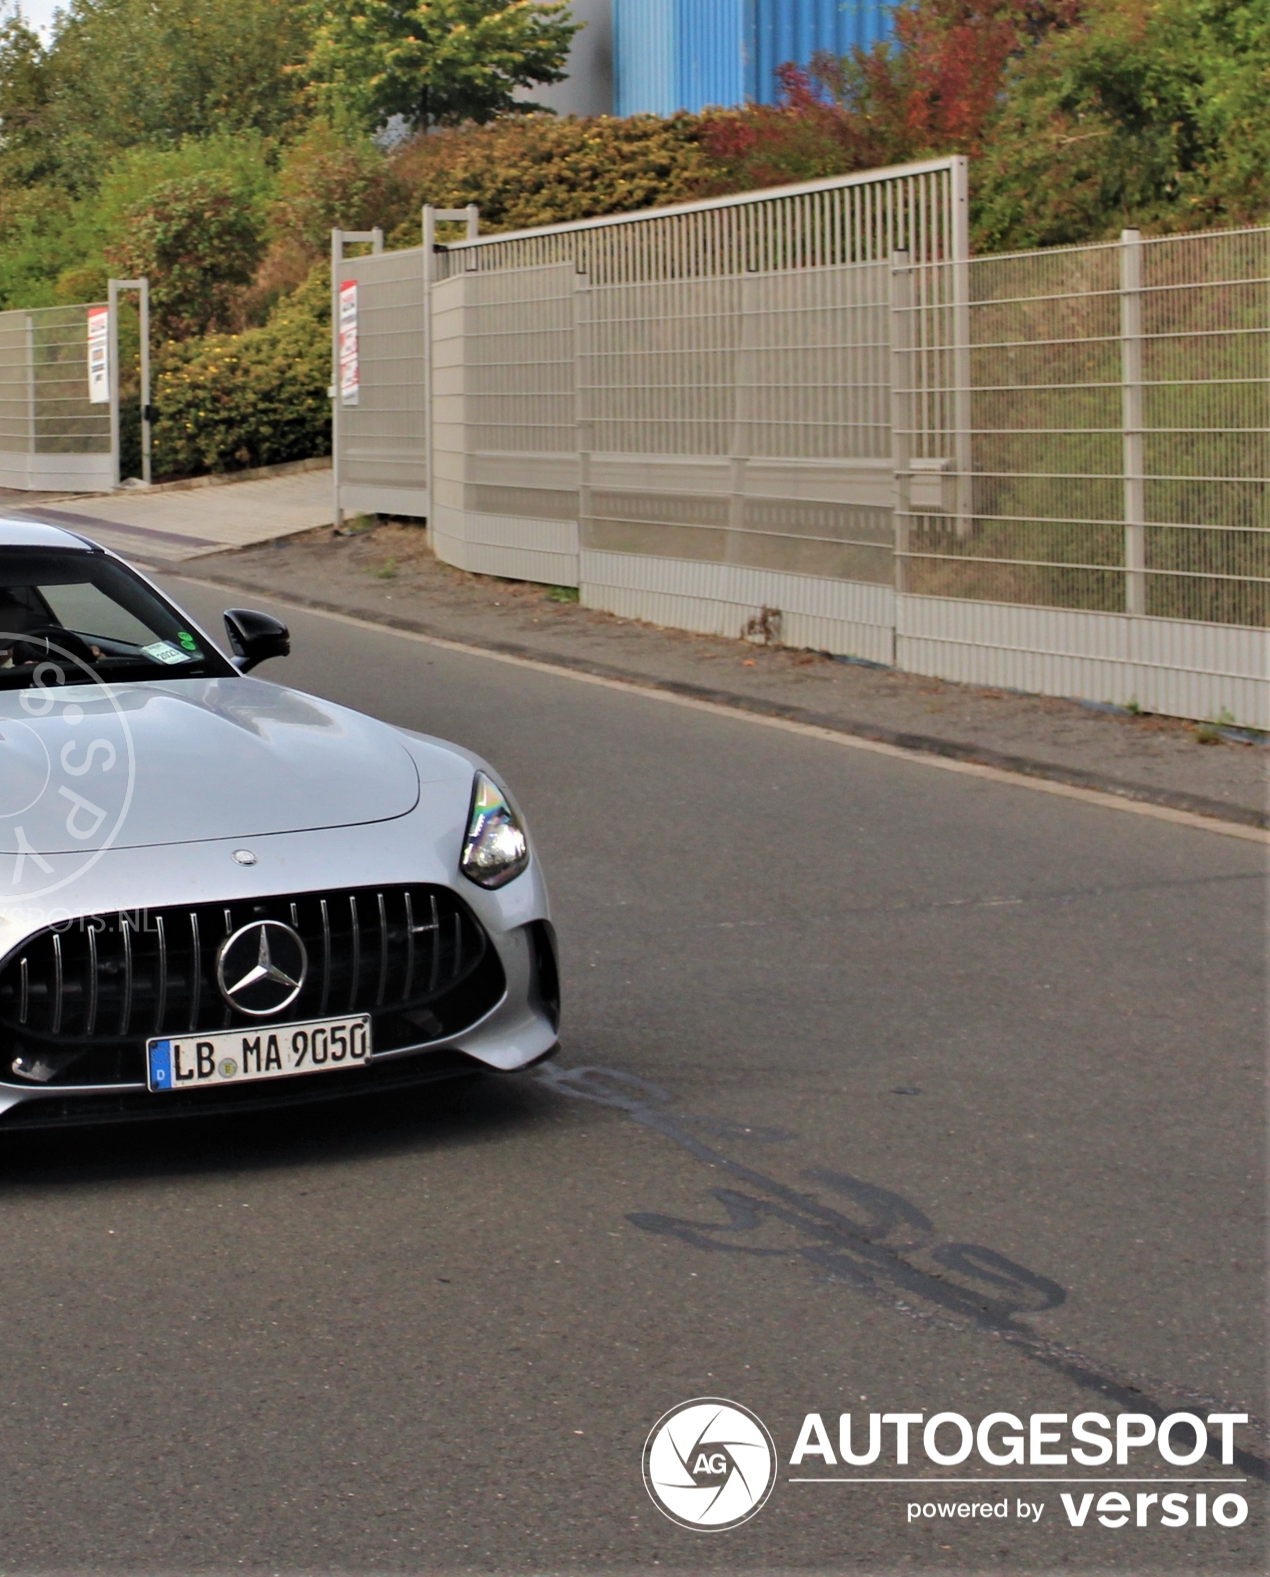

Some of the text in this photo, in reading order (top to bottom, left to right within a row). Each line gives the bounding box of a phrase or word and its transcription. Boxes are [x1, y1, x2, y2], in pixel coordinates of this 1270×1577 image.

[173, 1023, 367, 1081] LB MA 9050
[156, 1069, 165, 1081] D
